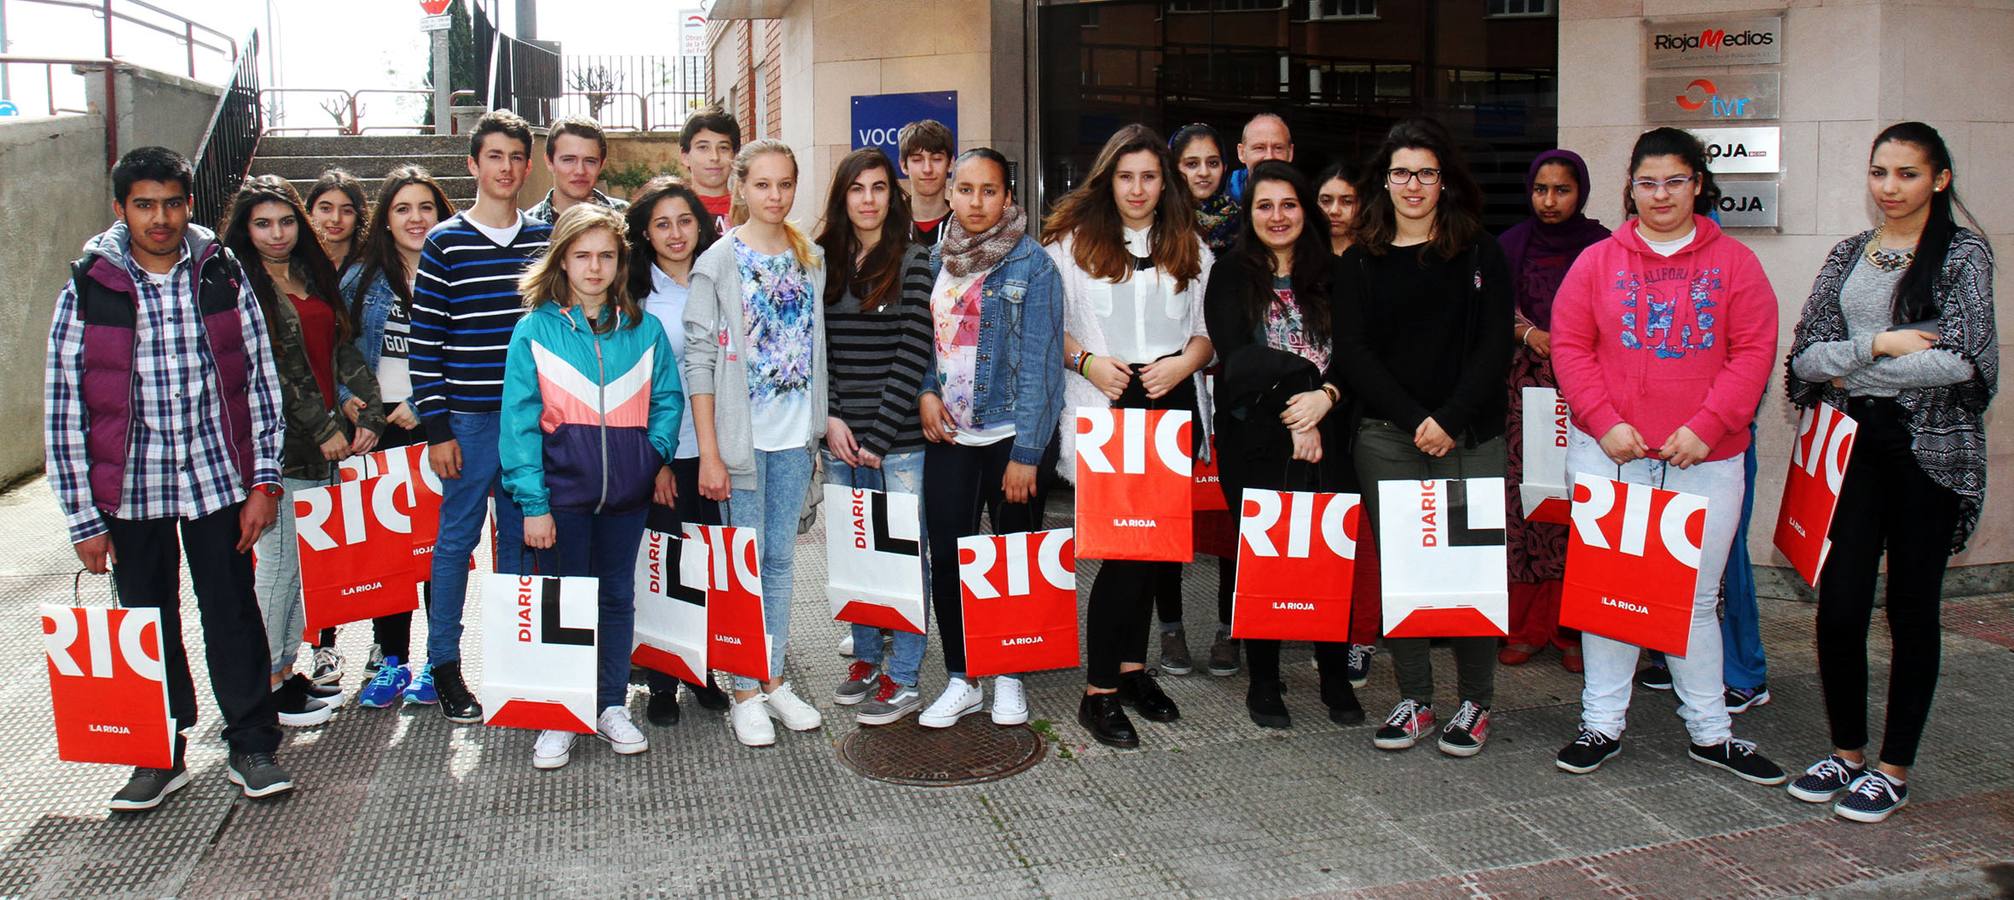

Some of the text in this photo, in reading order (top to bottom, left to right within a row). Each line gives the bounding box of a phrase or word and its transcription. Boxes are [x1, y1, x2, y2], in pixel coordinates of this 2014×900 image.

[1655, 28, 1773, 52] RiojaMedios
[1711, 95, 1751, 117] tvr
[1706, 143, 1748, 158] OJA
[1718, 196, 1763, 212] OJA
[1129, 518, 1157, 528] RIOJA
[356, 582, 382, 593] RIOJA
[1287, 602, 1314, 610] RIOJA
[1618, 601, 1649, 614] RIOJA
[1016, 636, 1043, 645] RIOJA
[103, 725, 130, 734] RIOJA
